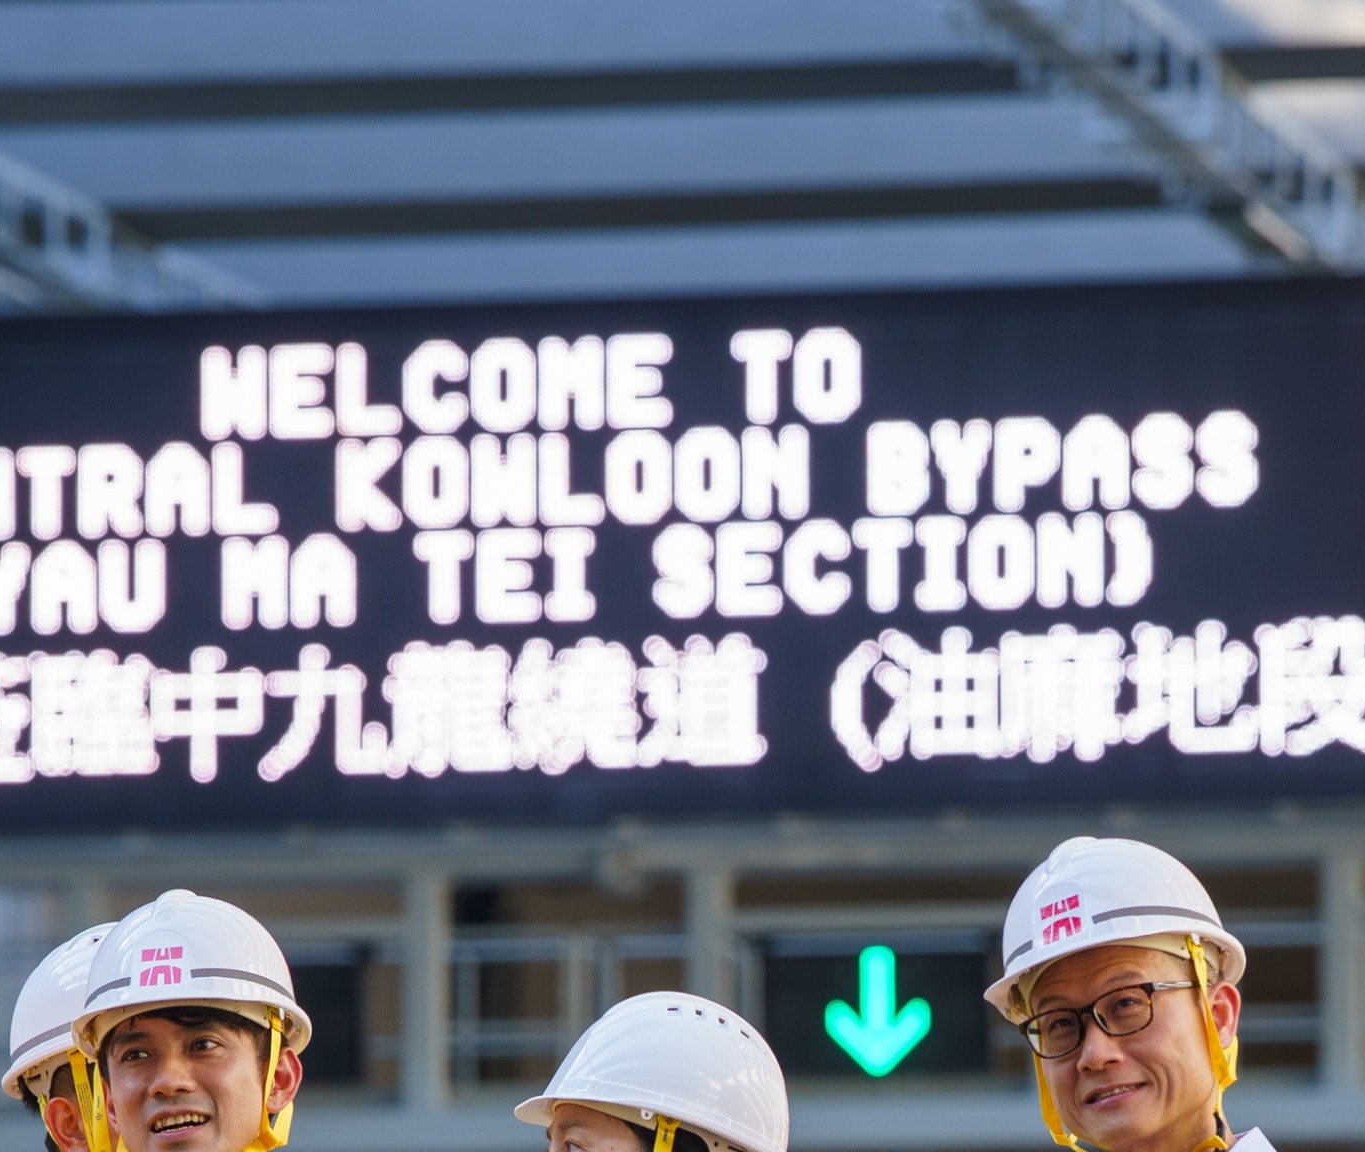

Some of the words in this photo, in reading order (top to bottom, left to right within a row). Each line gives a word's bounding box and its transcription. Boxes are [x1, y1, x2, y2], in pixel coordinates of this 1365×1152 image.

[200, 333, 674, 441] WELCOME
[730, 327, 862, 425] TO
[335, 424, 810, 532] KOWLOON
[866, 410, 1259, 516] BYPASS
[221, 533, 357, 630] MA
[413, 526, 596, 625] TEI
[652, 510, 1153, 618] SECTION)
